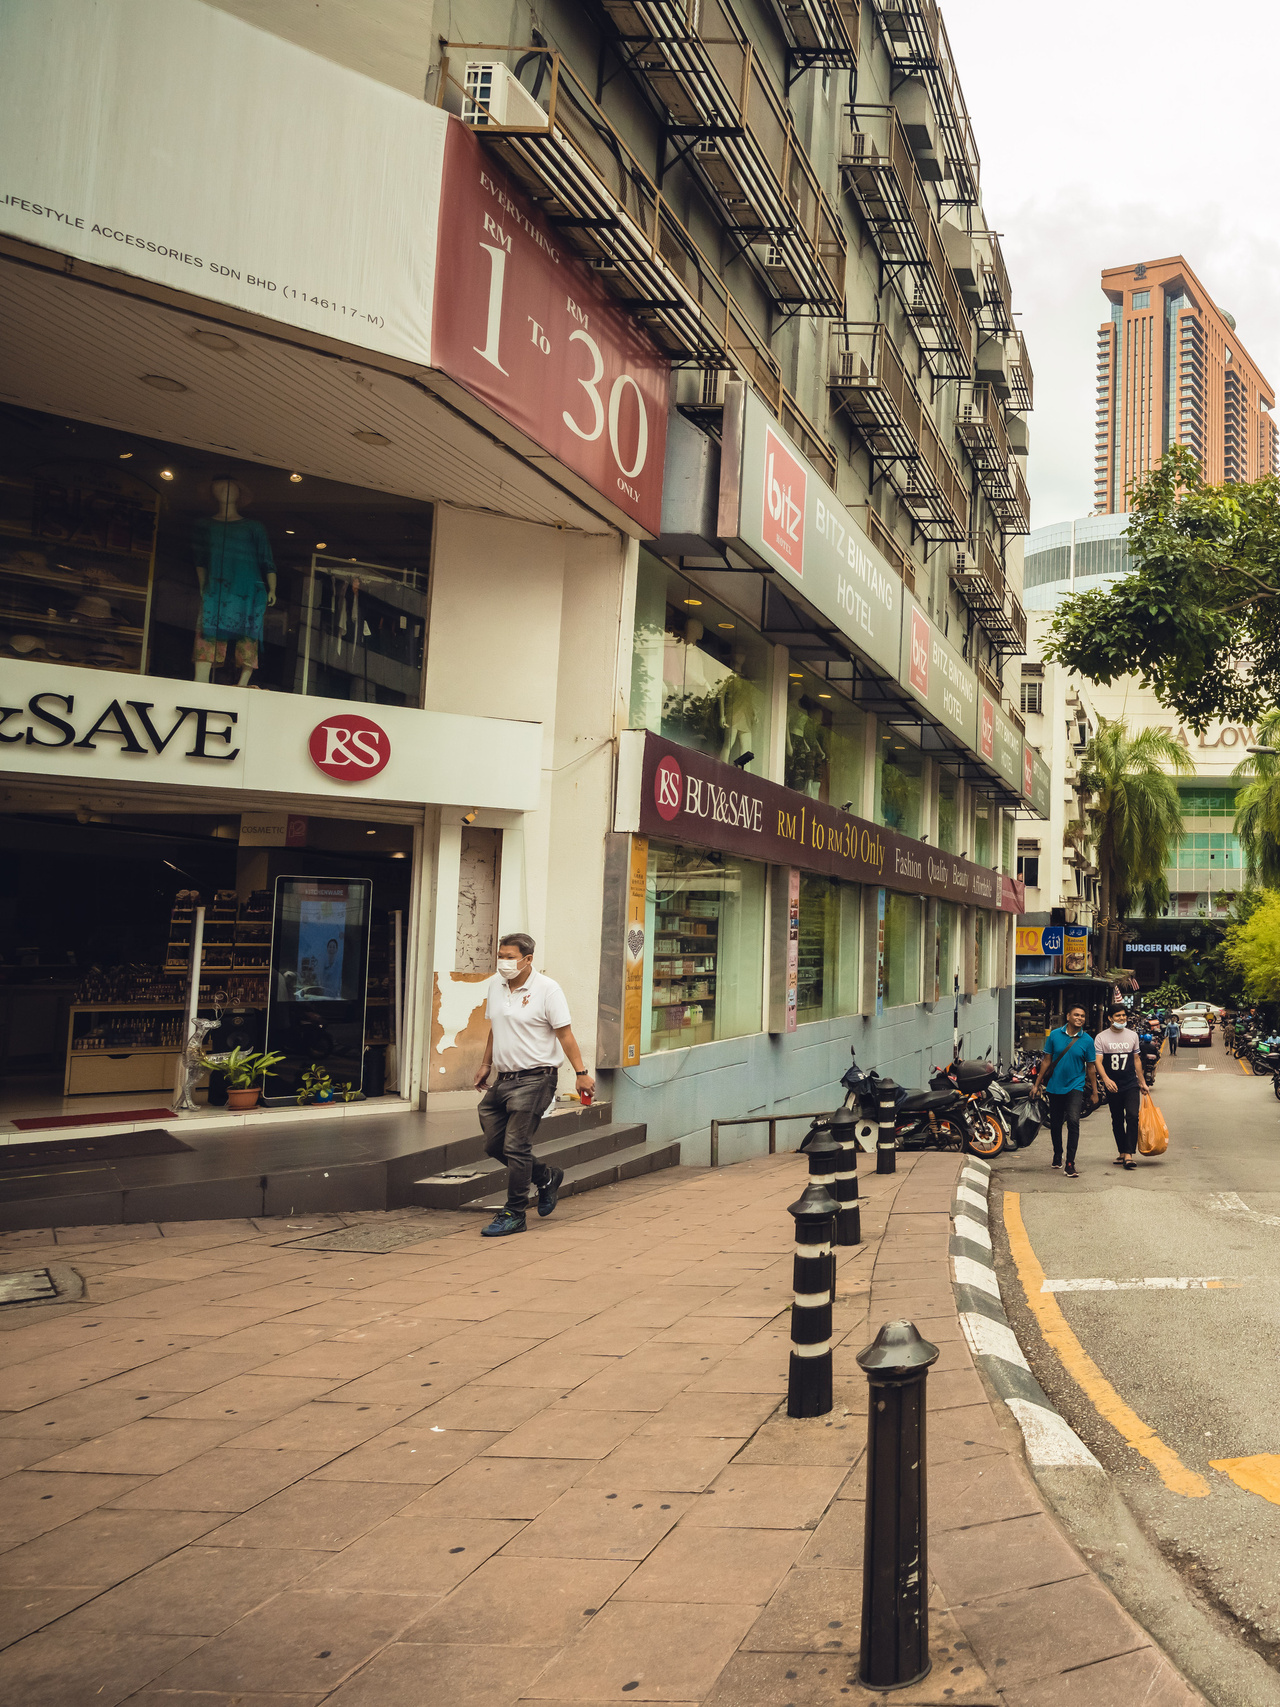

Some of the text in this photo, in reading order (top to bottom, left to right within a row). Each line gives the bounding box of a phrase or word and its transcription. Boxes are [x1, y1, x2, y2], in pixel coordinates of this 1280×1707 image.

[480, 171, 560, 265] EVERYTHING
[483, 211, 513, 254] RM
[0, 194, 386, 329] IFESTYLE ACCESSORIES SDN BHD (1146117-M)
[566, 295, 589, 331] RM
[473, 241, 648, 478] 1 To 30
[616, 476, 641, 503] ONLY
[767, 452, 802, 543] bitz
[815, 497, 893, 611] BITZ BINTANG
[836, 573, 874, 638] HOTEL
[932, 641, 973, 703] BITZ BINTANG
[943, 687, 964, 726] HOTEL
[241, 824, 285, 835] COSMETIC
[684, 774, 764, 833] BUY&SAVE
[812, 814, 825, 850] to
[861, 829, 886, 876] Only
[895, 847, 922, 879] Fashion
[928, 855, 949, 889] Quality
[952, 863, 970, 893] Beauty
[972, 874, 993, 899] Affordable
[1125, 944, 1187, 952] BURGER KING
[1108, 1042, 1130, 1050] TOKYO
[1110, 1053, 1129, 1071] 87
